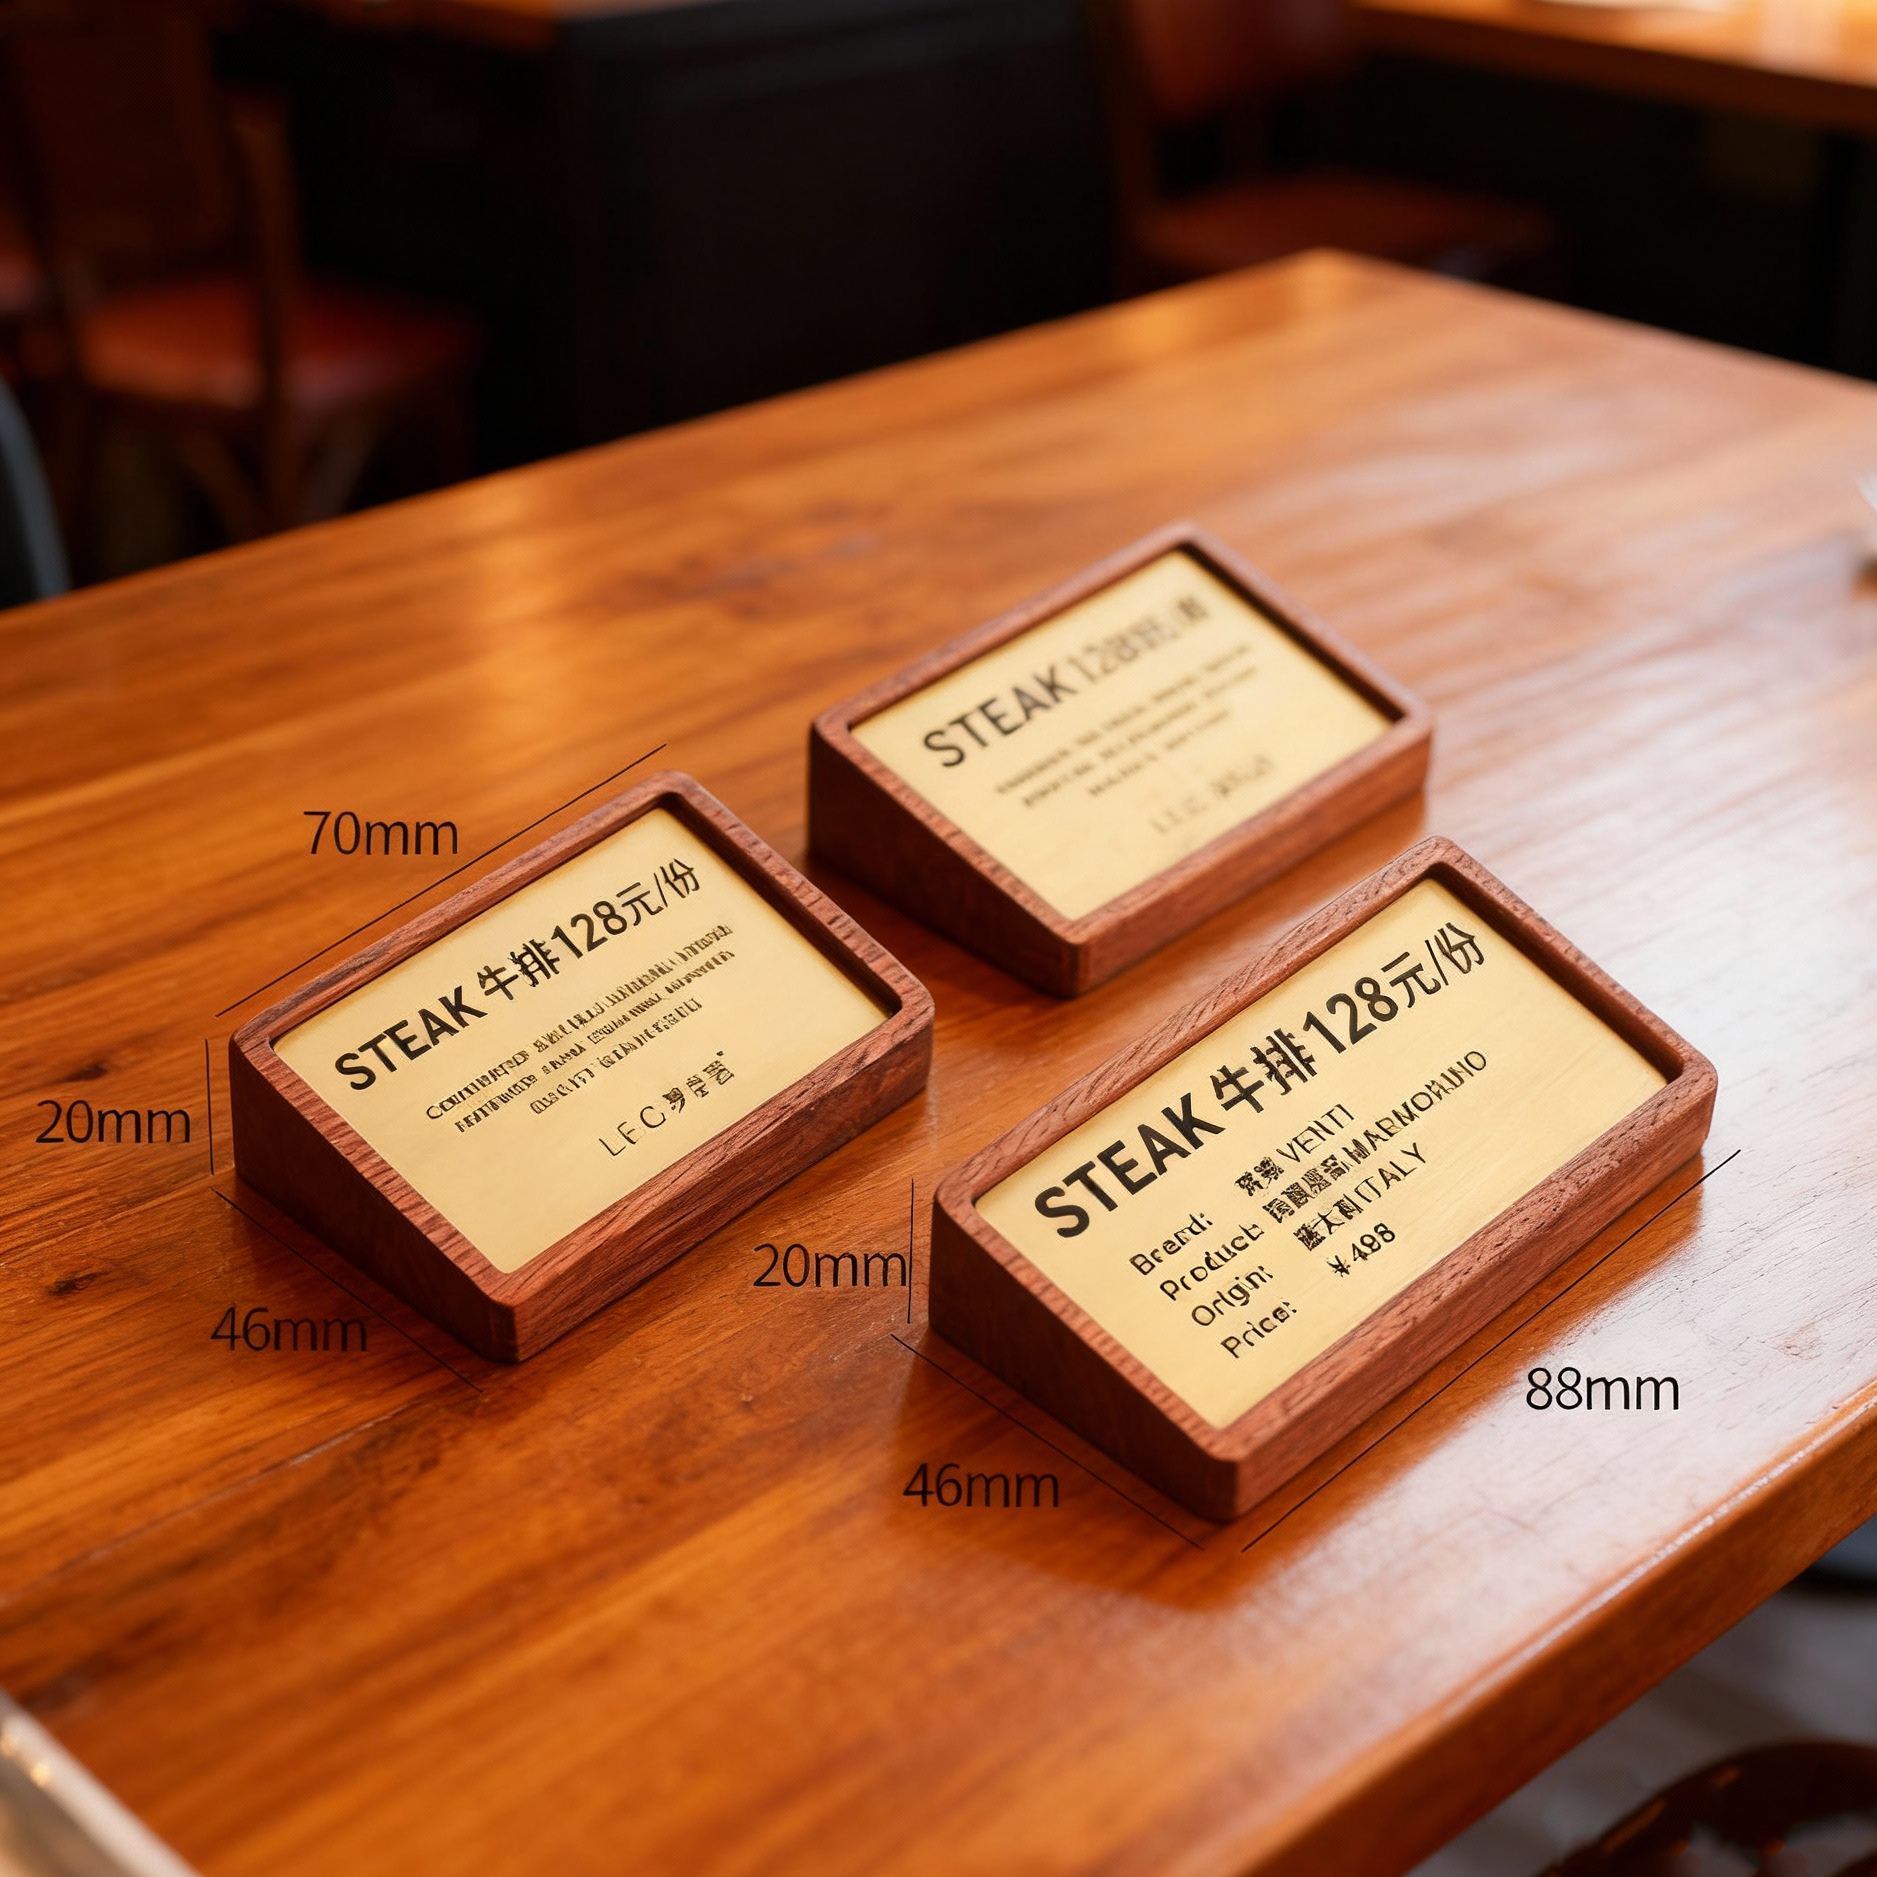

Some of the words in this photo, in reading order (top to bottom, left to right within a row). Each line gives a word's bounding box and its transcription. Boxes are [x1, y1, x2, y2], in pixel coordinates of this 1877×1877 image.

[923, 665, 1078, 767] STEAK
[335, 985, 488, 1090] STEAK
[1034, 1092, 1226, 1239] STEAK
